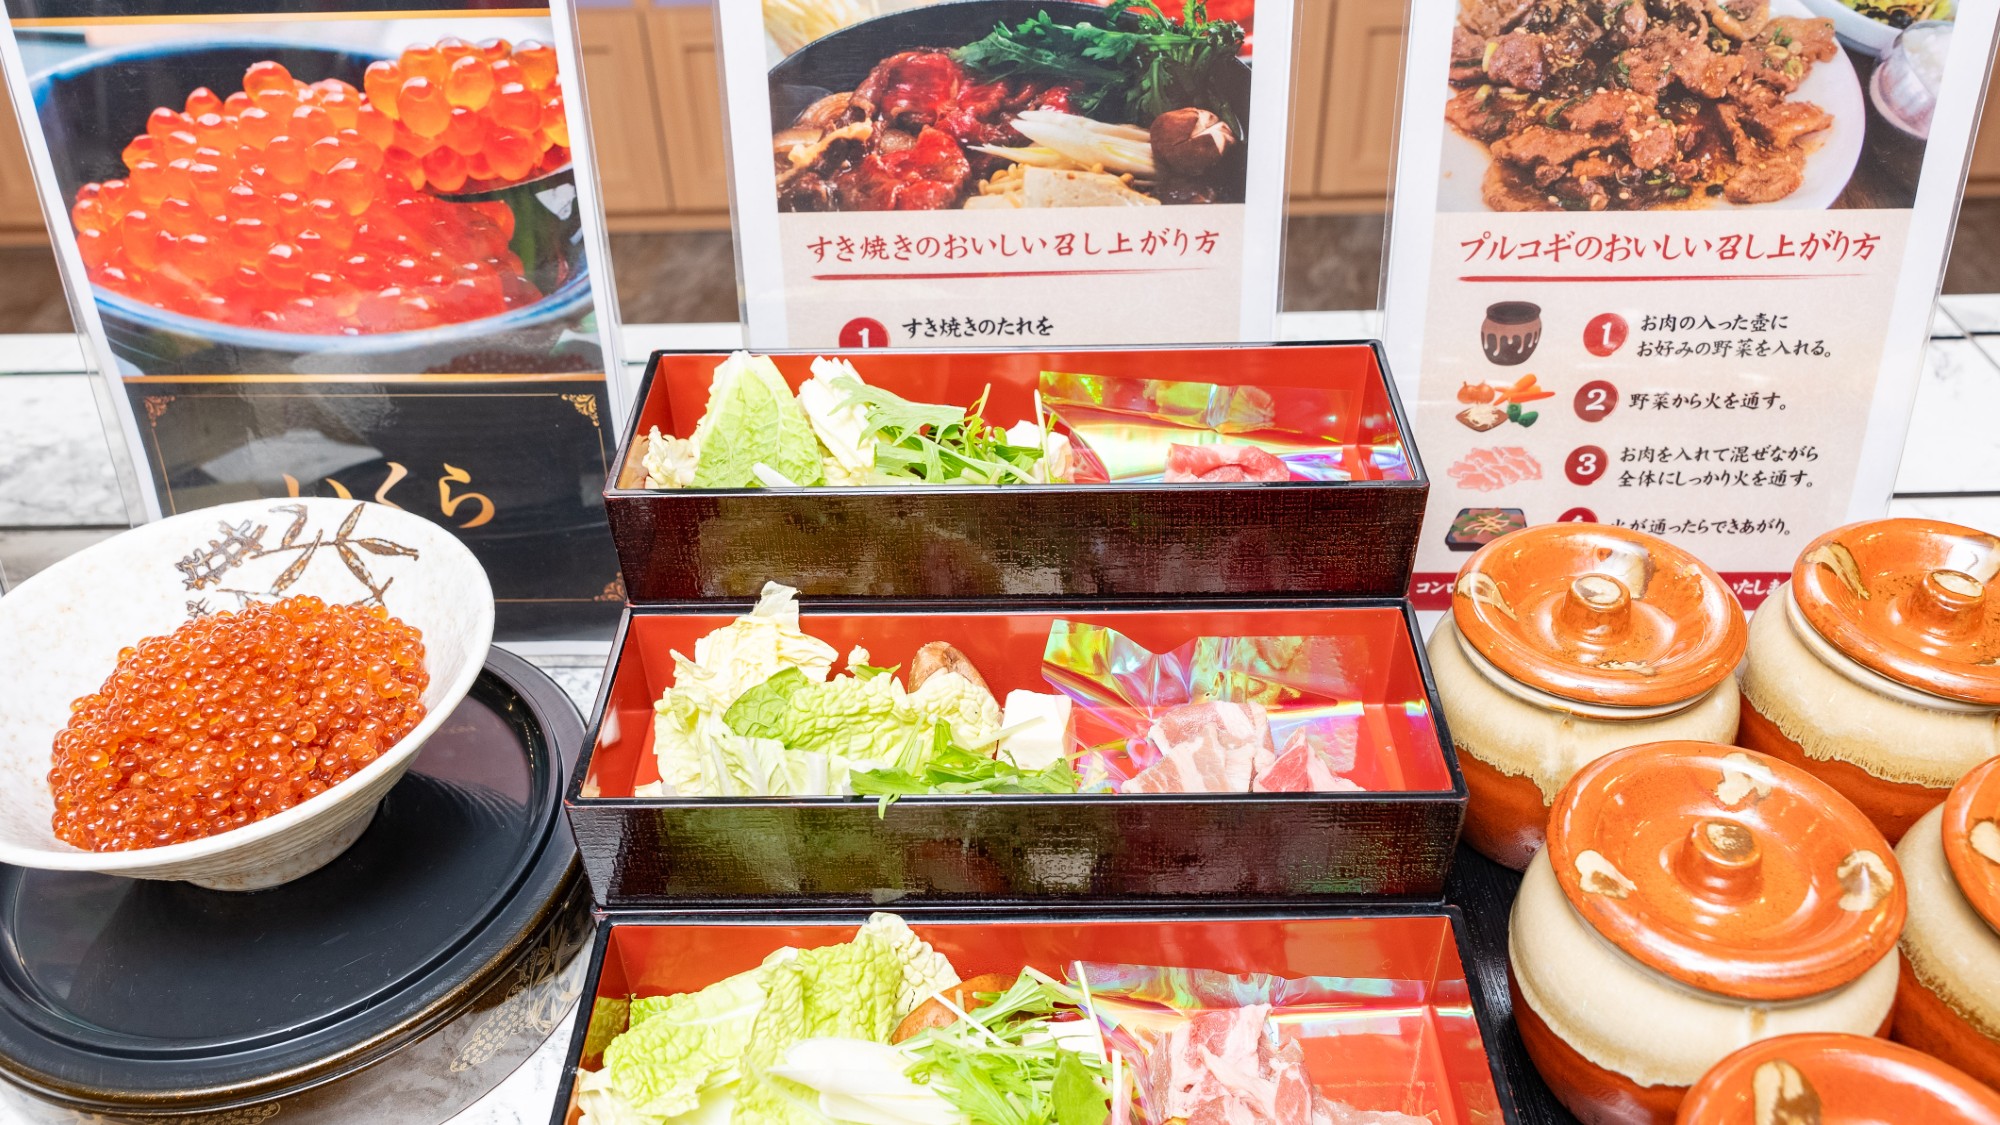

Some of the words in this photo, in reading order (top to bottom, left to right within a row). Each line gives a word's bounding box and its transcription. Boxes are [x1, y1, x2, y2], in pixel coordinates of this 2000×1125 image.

[806, 227, 1220, 263] すき焼きのおいしい召し上がり方
[1459, 229, 1882, 264] プルコギのおいしい召し上がり方
[902, 316, 1054, 338] すき焼きのたれを
[1601, 319, 1614, 347] 1
[1636, 338, 1832, 359] お好みの野菜を入れる。
[1585, 388, 1607, 412] 2
[1629, 392, 1787, 412] 野菜から火を通す。
[1575, 451, 1597, 476] 3
[1618, 445, 1819, 464] お肉を入れて混ぜながら
[1617, 469, 1815, 489] 全体にしっかり火を通す。
